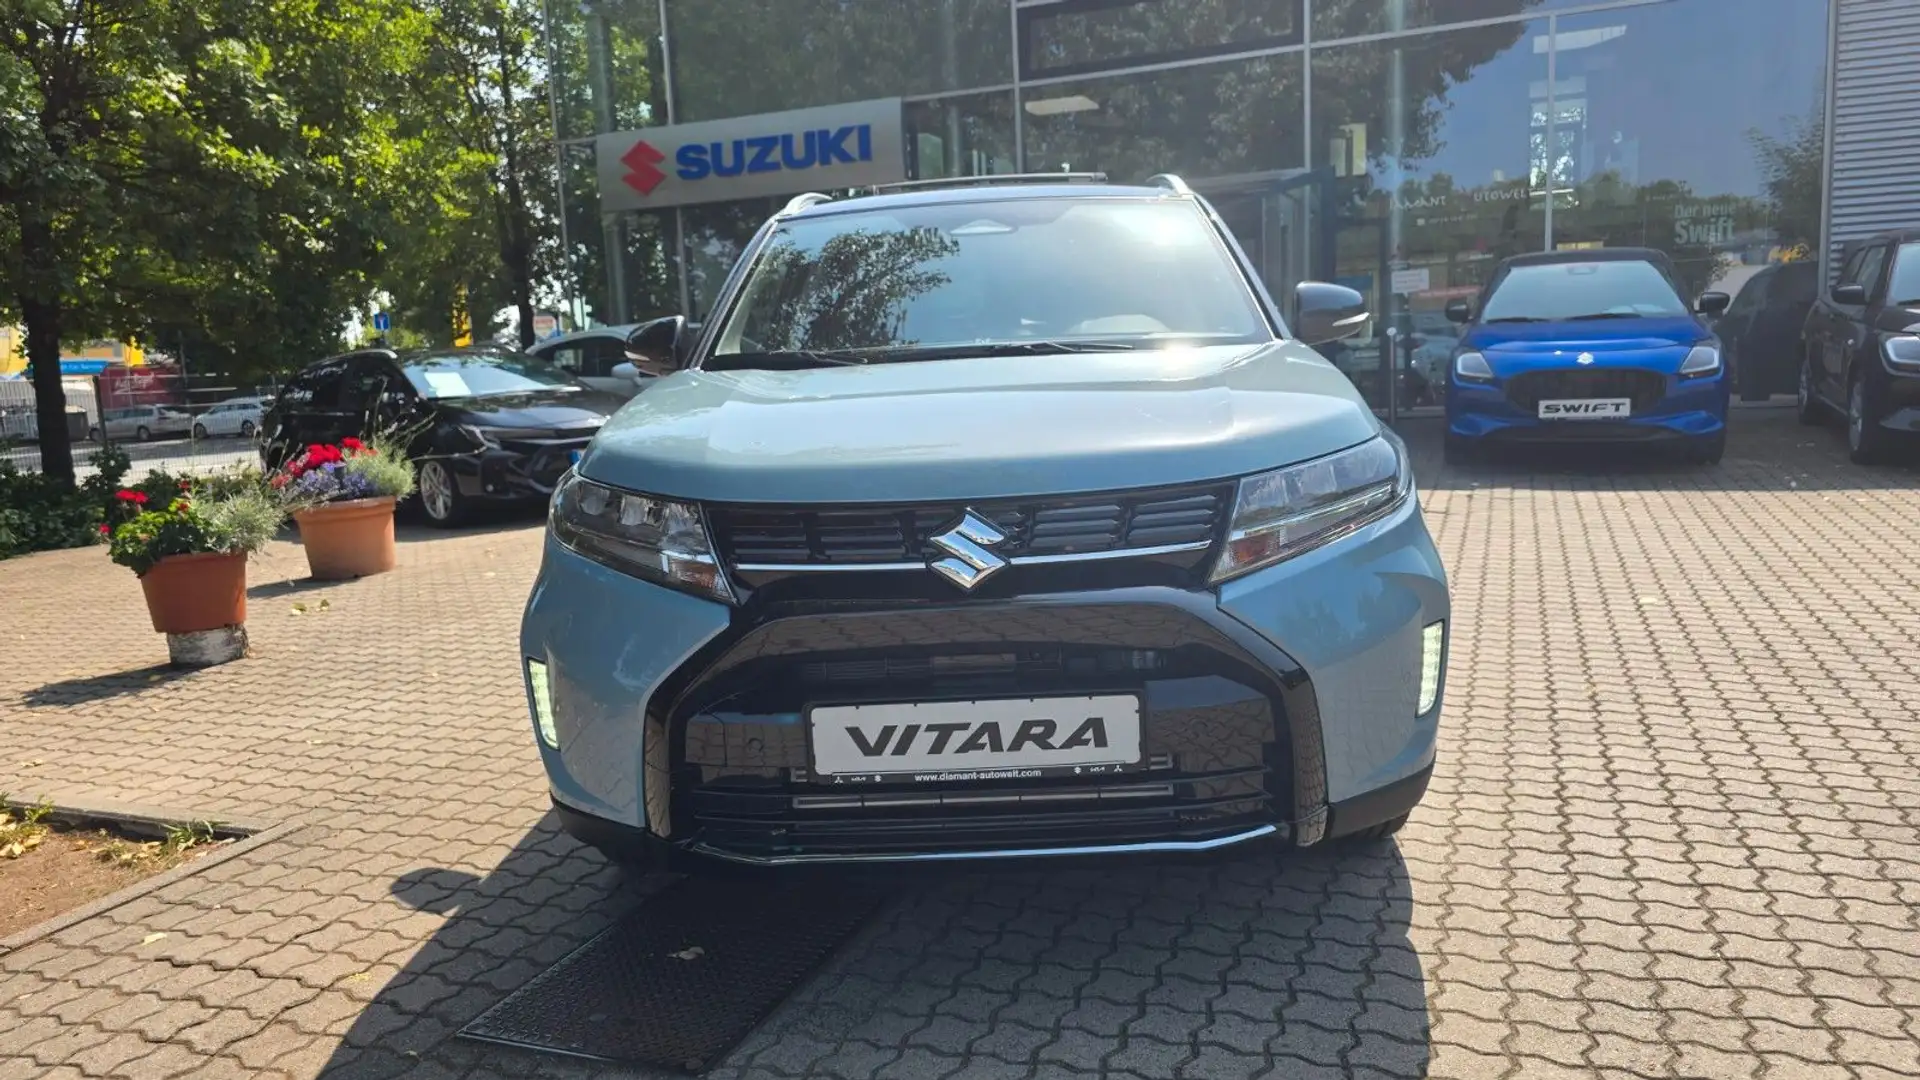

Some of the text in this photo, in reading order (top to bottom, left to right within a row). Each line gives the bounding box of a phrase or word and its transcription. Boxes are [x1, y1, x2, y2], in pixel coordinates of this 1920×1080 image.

[675, 124, 873, 181] SUZUKI
[1674, 216, 1736, 245] Swift
[1542, 402, 1627, 414] SWIFT
[844, 717, 1109, 757] VITARA
[914, 769, 1042, 782] www.diamant-autowelt.com
